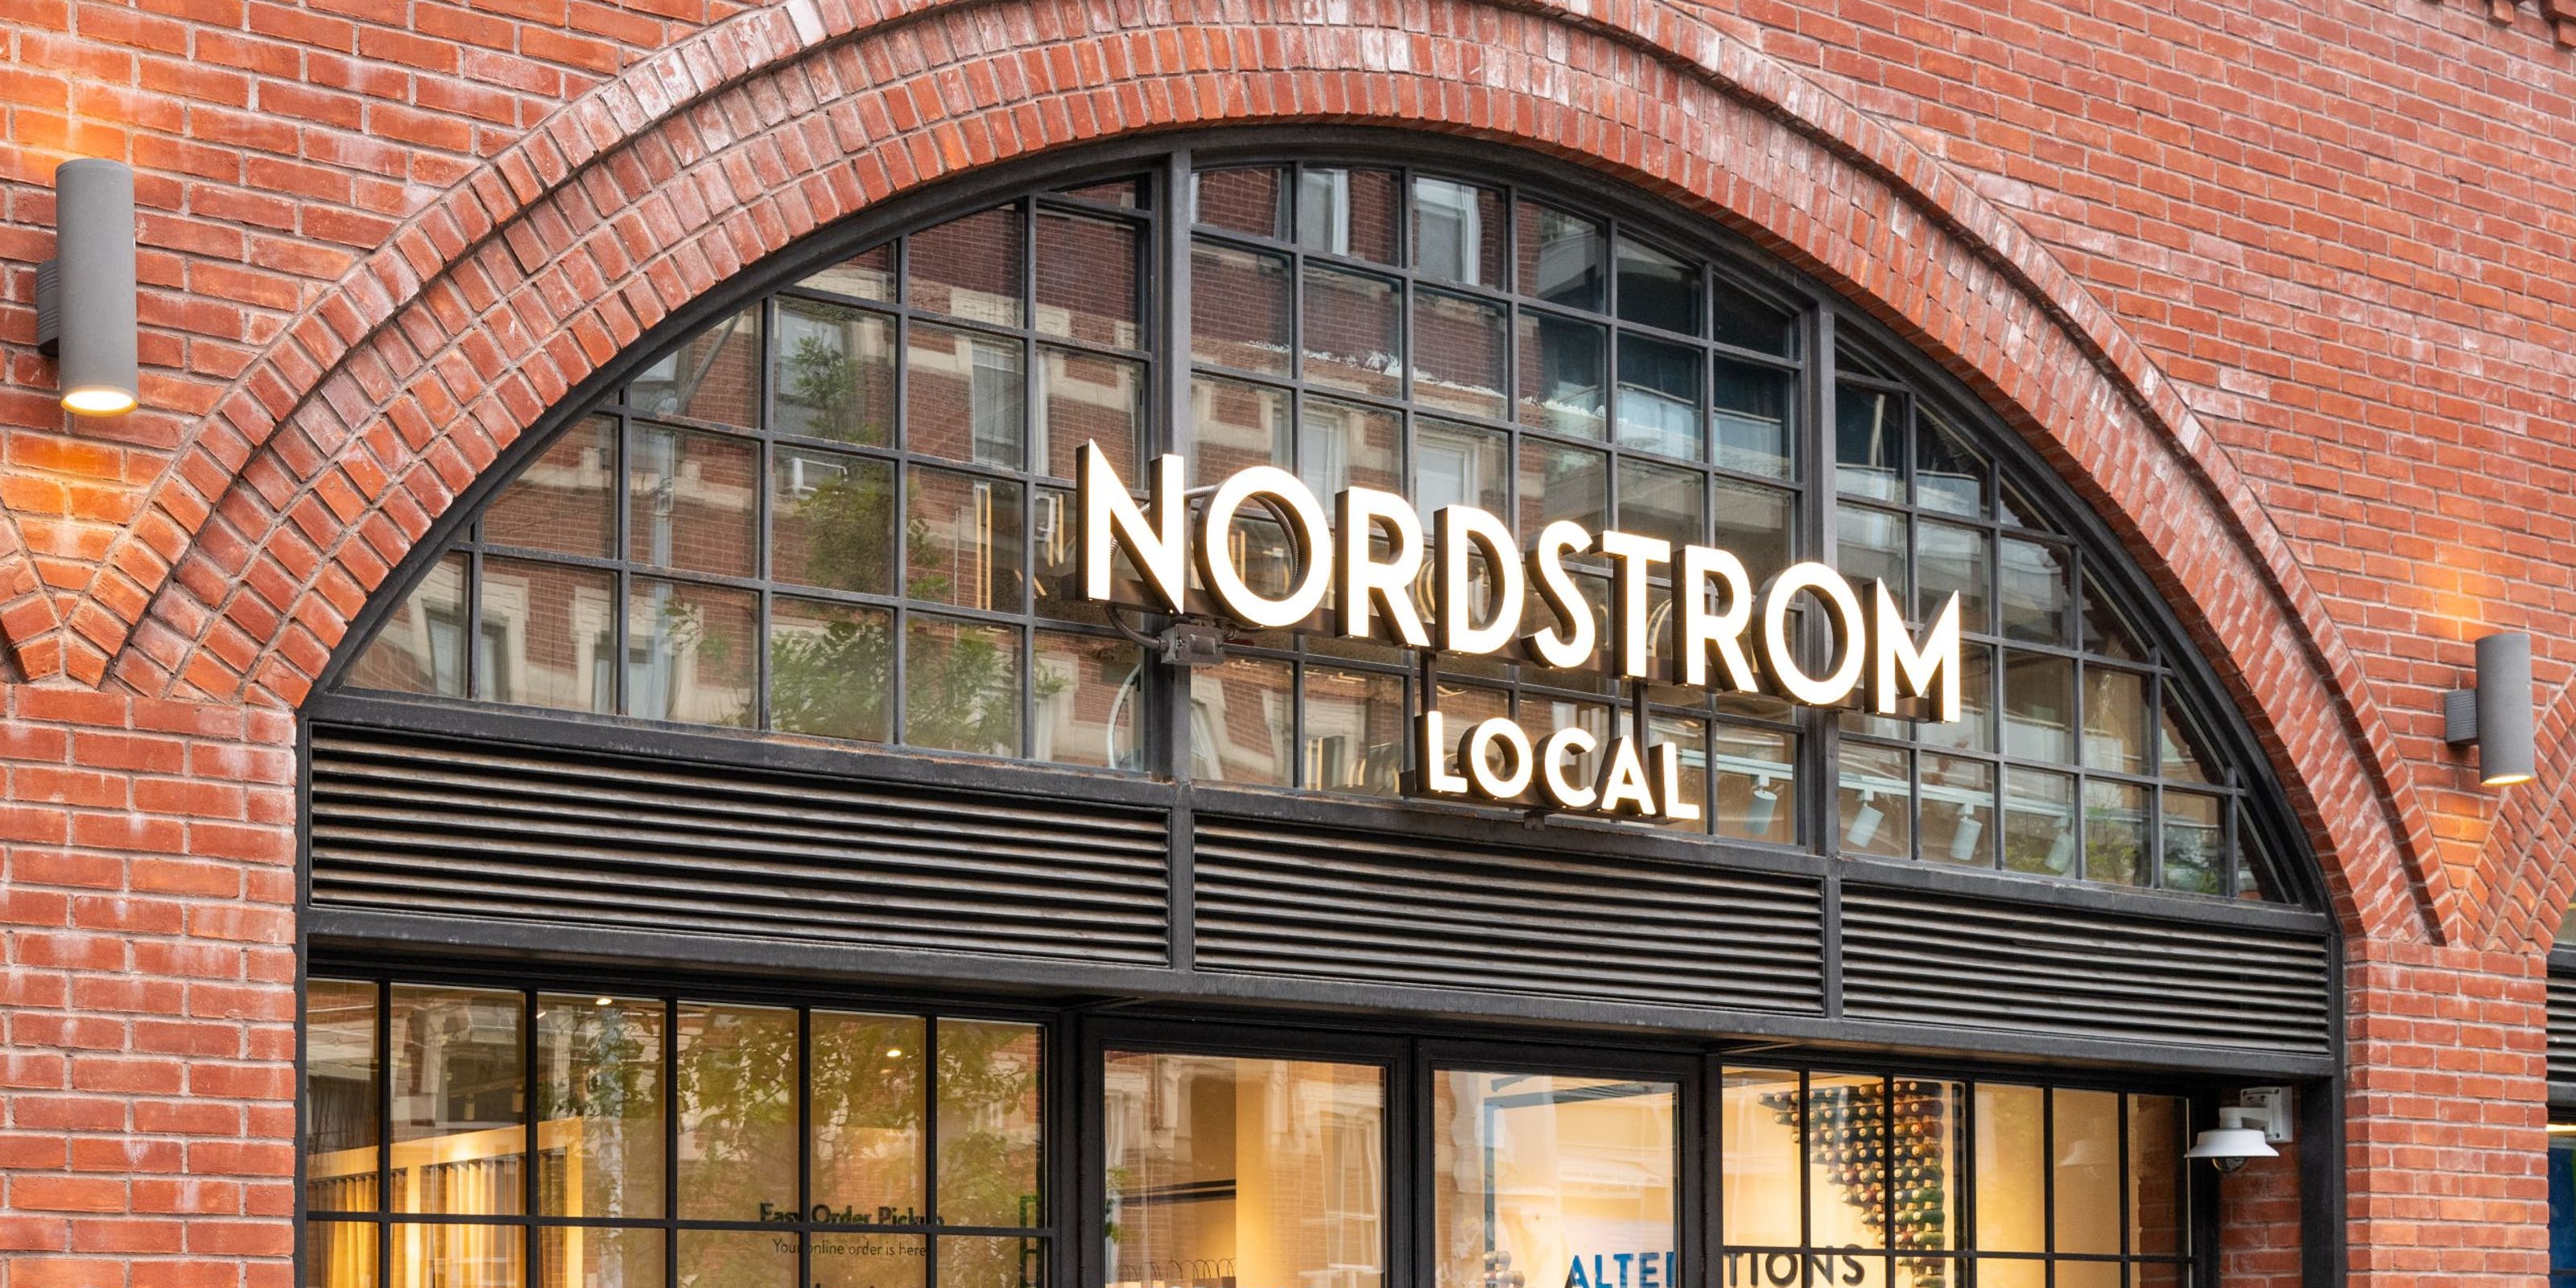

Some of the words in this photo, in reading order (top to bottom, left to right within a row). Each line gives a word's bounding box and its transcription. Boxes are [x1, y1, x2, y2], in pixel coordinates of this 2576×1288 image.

[1080, 437, 1961, 723] NORDSTROM
[1420, 710, 1700, 819] LOCAL
[811, 1203, 872, 1224] Order
[772, 1238, 799, 1253] You
[809, 1240, 844, 1255] nline
[848, 1241, 883, 1256] order
[886, 1241, 896, 1256] is
